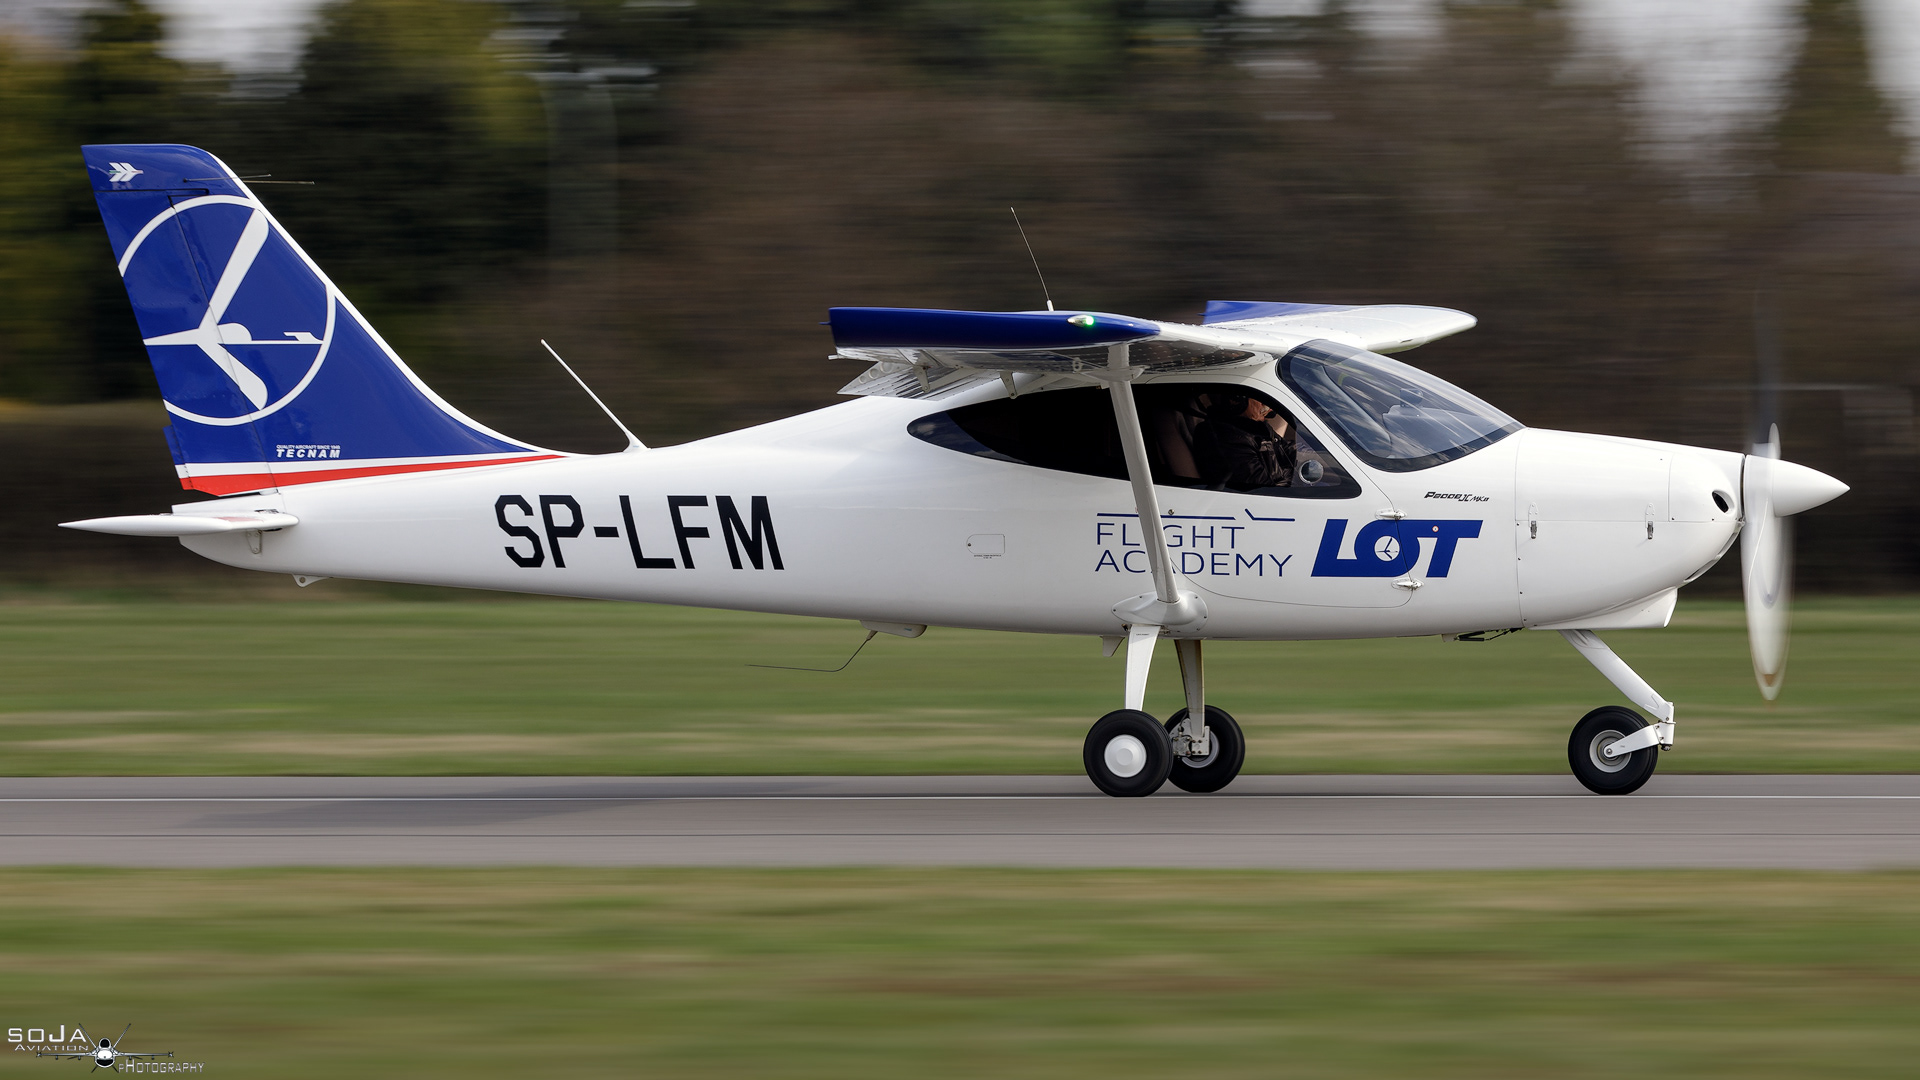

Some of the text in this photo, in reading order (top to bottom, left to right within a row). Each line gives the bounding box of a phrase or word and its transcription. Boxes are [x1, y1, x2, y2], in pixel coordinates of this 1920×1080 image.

[276, 449, 341, 458] TECNAM
[494, 494, 785, 570] SP-LFM
[1096, 522, 1245, 549] FLGHT
[1310, 518, 1484, 578] LOT
[1094, 549, 1293, 577] ACDEMY
